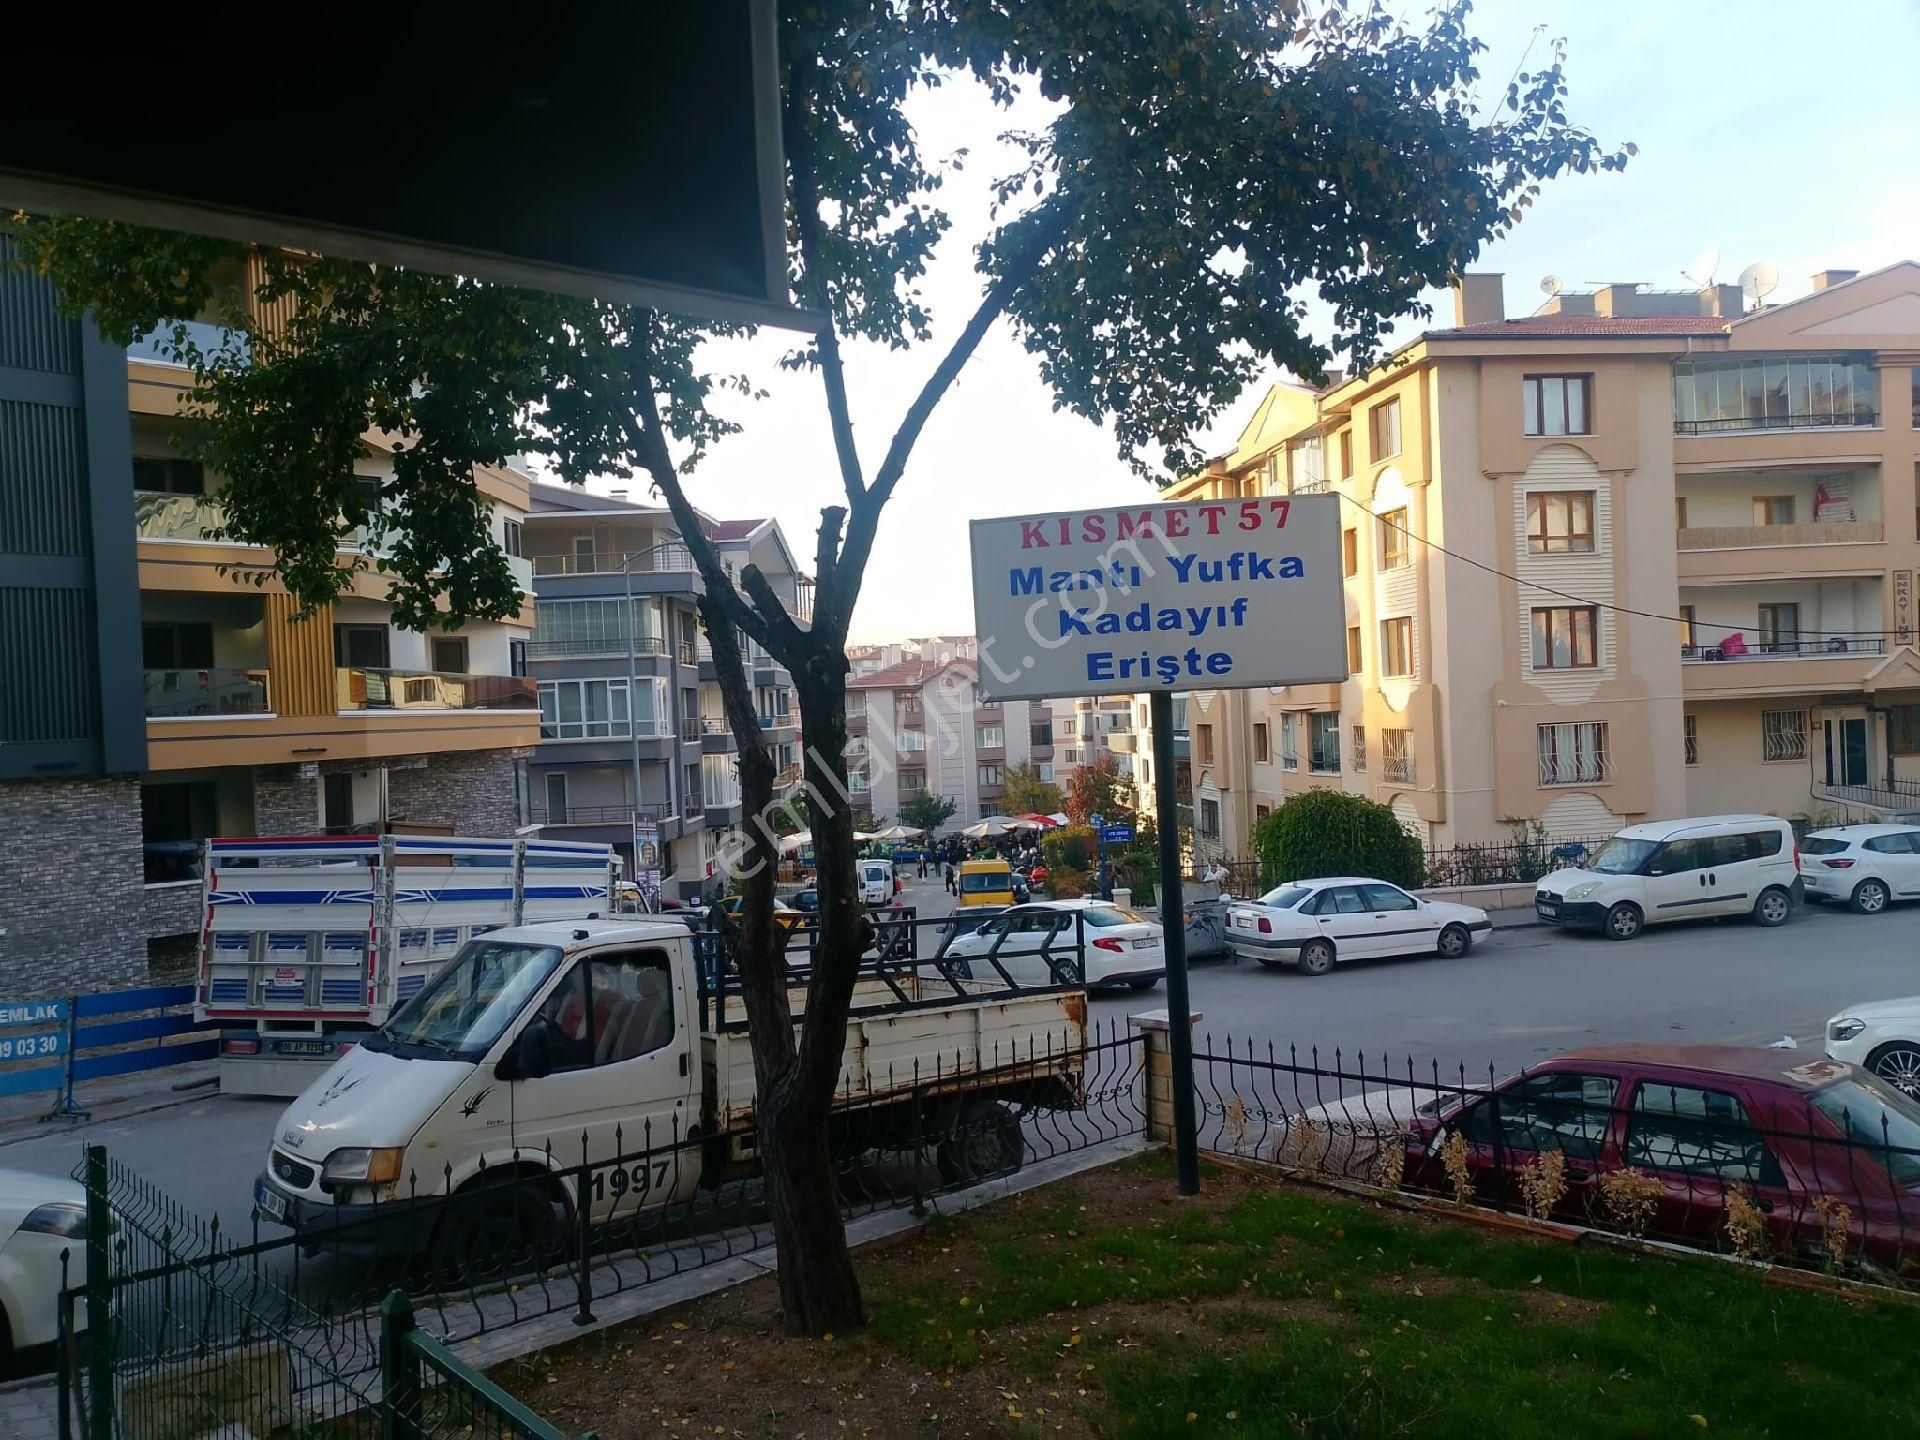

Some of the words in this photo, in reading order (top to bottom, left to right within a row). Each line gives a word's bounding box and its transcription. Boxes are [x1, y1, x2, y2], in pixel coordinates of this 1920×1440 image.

[1010, 560, 1141, 597] Mantı
[1166, 552, 1305, 584] Yufka
[1058, 598, 1249, 637] Kadayıf
[1086, 647, 1234, 685] Erişte
[0, 1005, 58, 1023] EMLAK
[17, 1039, 36, 1056] 03
[40, 1036, 58, 1053] 30
[591, 1161, 670, 1201] 1997
